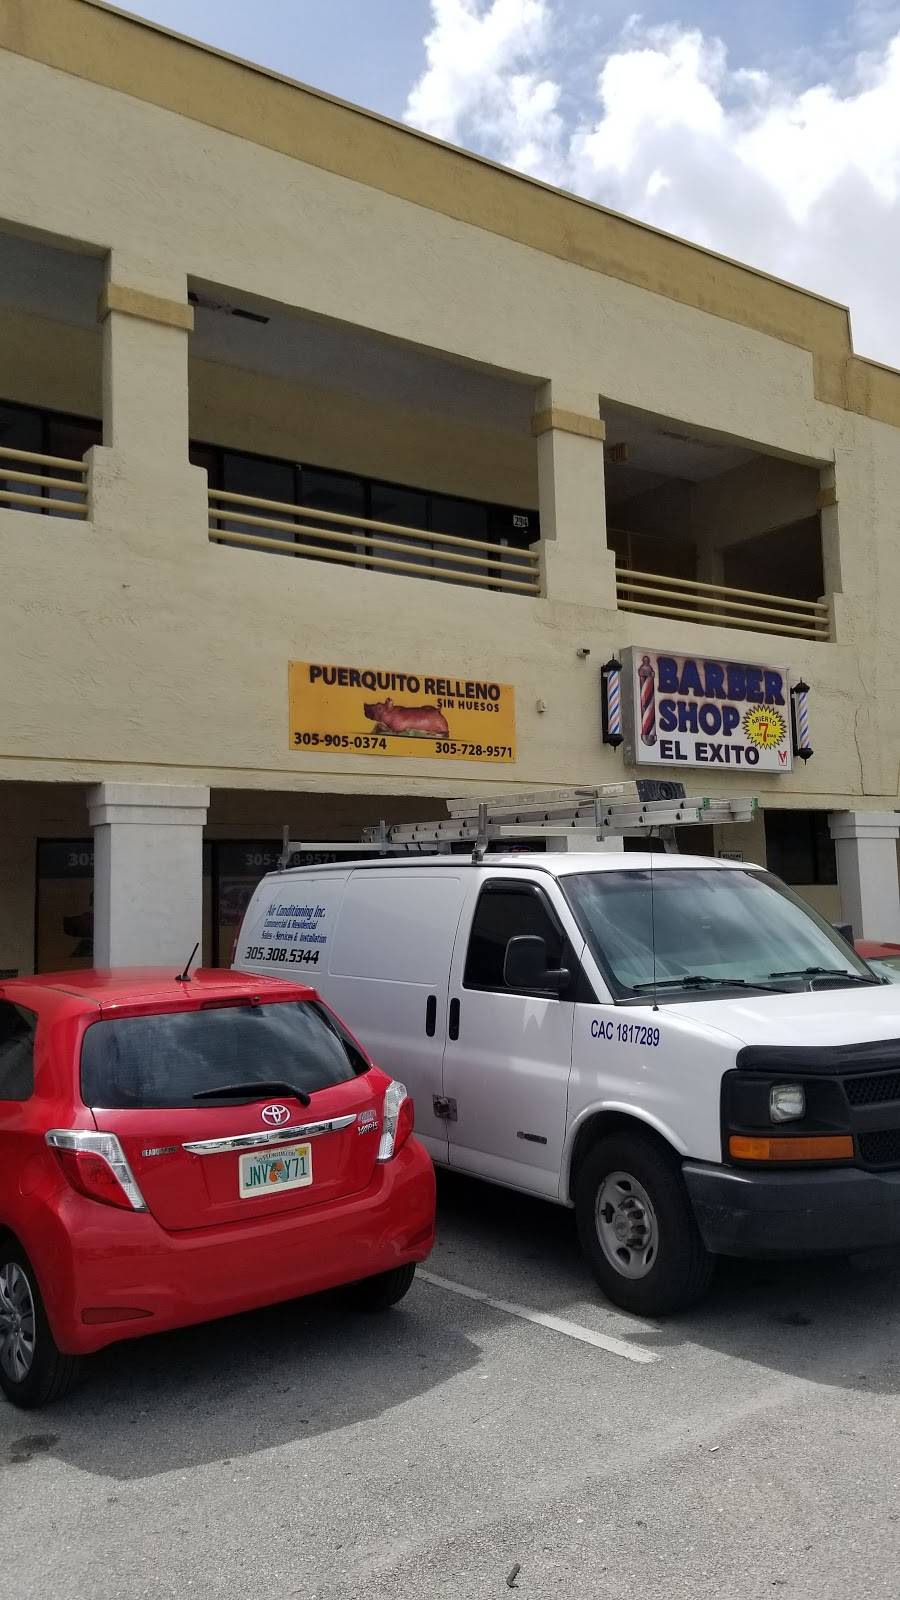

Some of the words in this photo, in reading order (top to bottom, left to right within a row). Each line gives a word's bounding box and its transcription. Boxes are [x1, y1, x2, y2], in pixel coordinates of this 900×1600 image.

[309, 665, 420, 693] PUERQUITO
[424, 678, 501, 700] RELLENO
[657, 656, 785, 705] BARBER
[437, 698, 454, 709] SIN
[458, 700, 500, 713] HUESOS
[658, 699, 741, 736] SHOP
[751, 715, 777, 727] ABIERTO
[294, 732, 387, 750] 305-905-0374
[758, 722, 769, 742] 7
[435, 742, 513, 758] 305-728-9571
[660, 740, 688, 760] EL
[694, 742, 760, 765] EXITO
[266, 904, 276, 917] Air
[276, 904, 315, 920] Conditioning
[314, 904, 326, 918] Inc.
[264, 919, 288, 928] Commercial
[292, 920, 319, 930] Residential
[261, 930, 272, 940] Sales
[299, 932, 327, 943] Installation
[245, 946, 320, 965] 305.308.5344
[591, 1019, 614, 1040] CAC
[616, 1023, 660, 1047] 1817289
[284, 1156, 307, 1180] Y71
